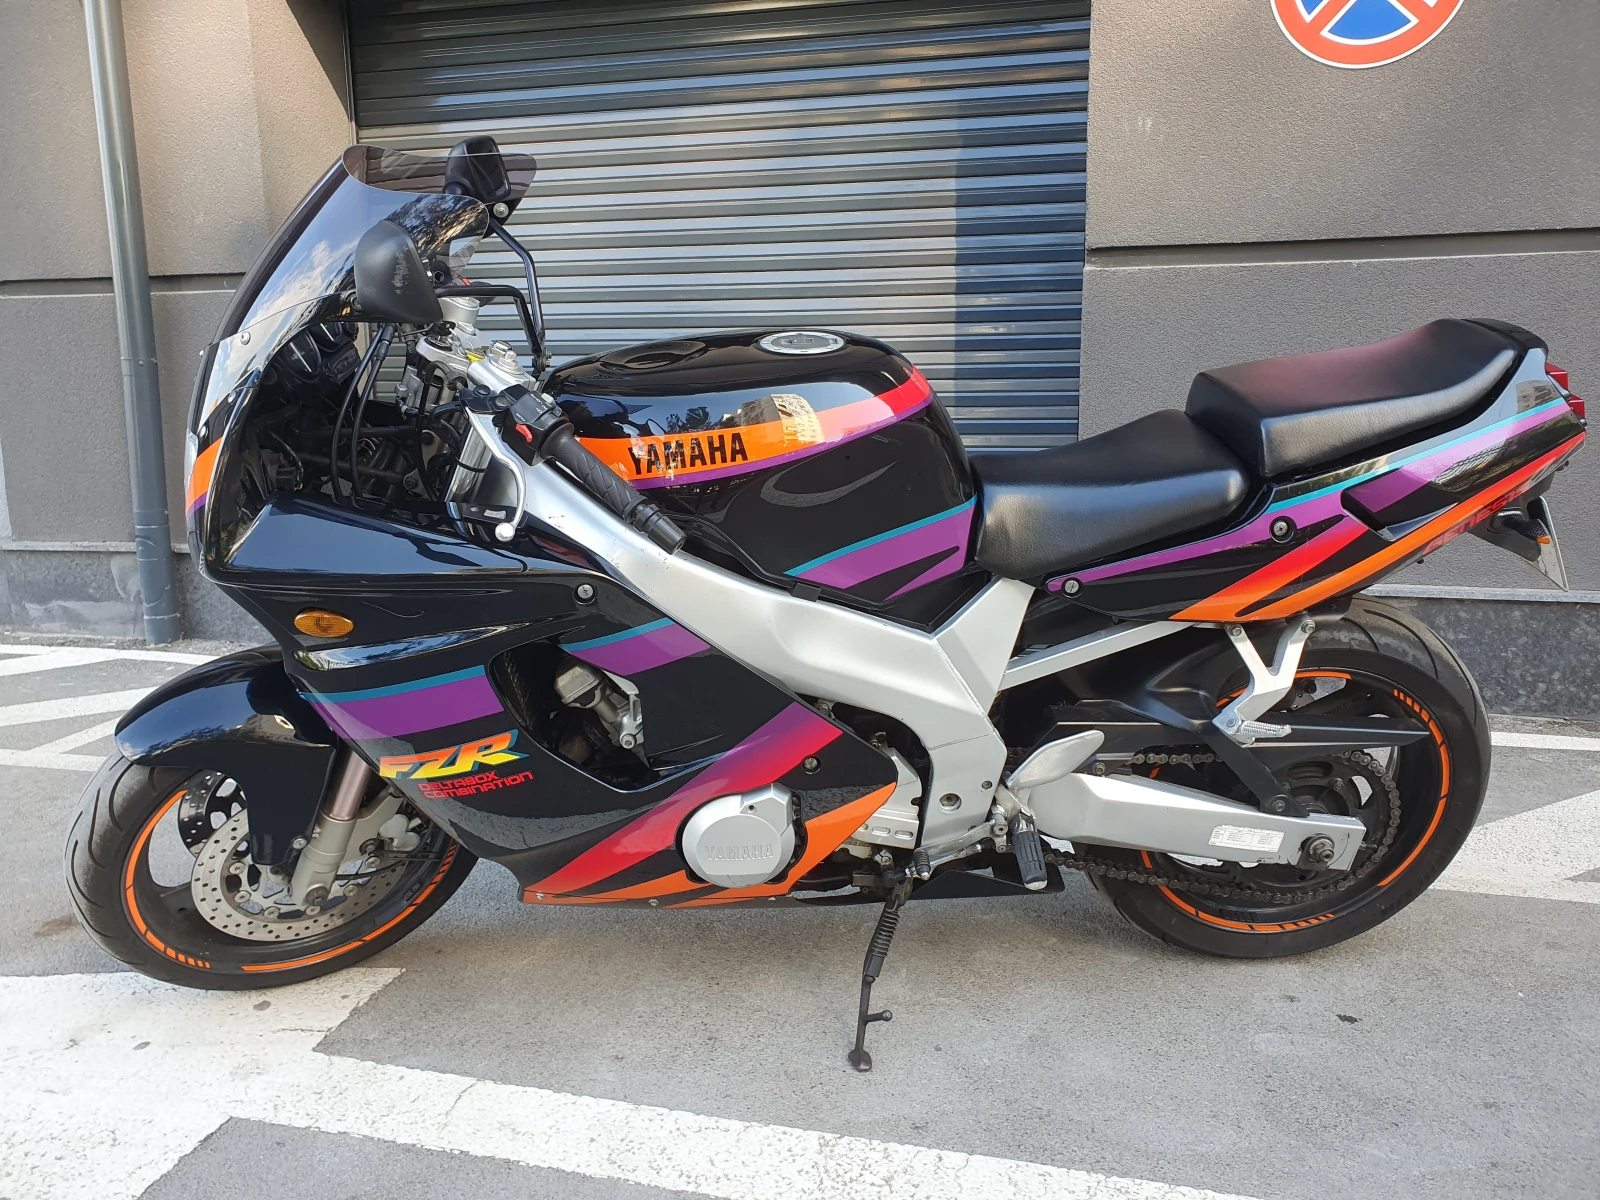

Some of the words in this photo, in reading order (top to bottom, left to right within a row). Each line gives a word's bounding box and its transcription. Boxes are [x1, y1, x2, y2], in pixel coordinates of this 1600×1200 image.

[627, 432, 748, 475] YAMAHA
[379, 729, 530, 779] FZR
[418, 771, 500, 792] DELTABOX
[423, 771, 535, 799] COMBINATION
[705, 843, 774, 861] YAMAHA
